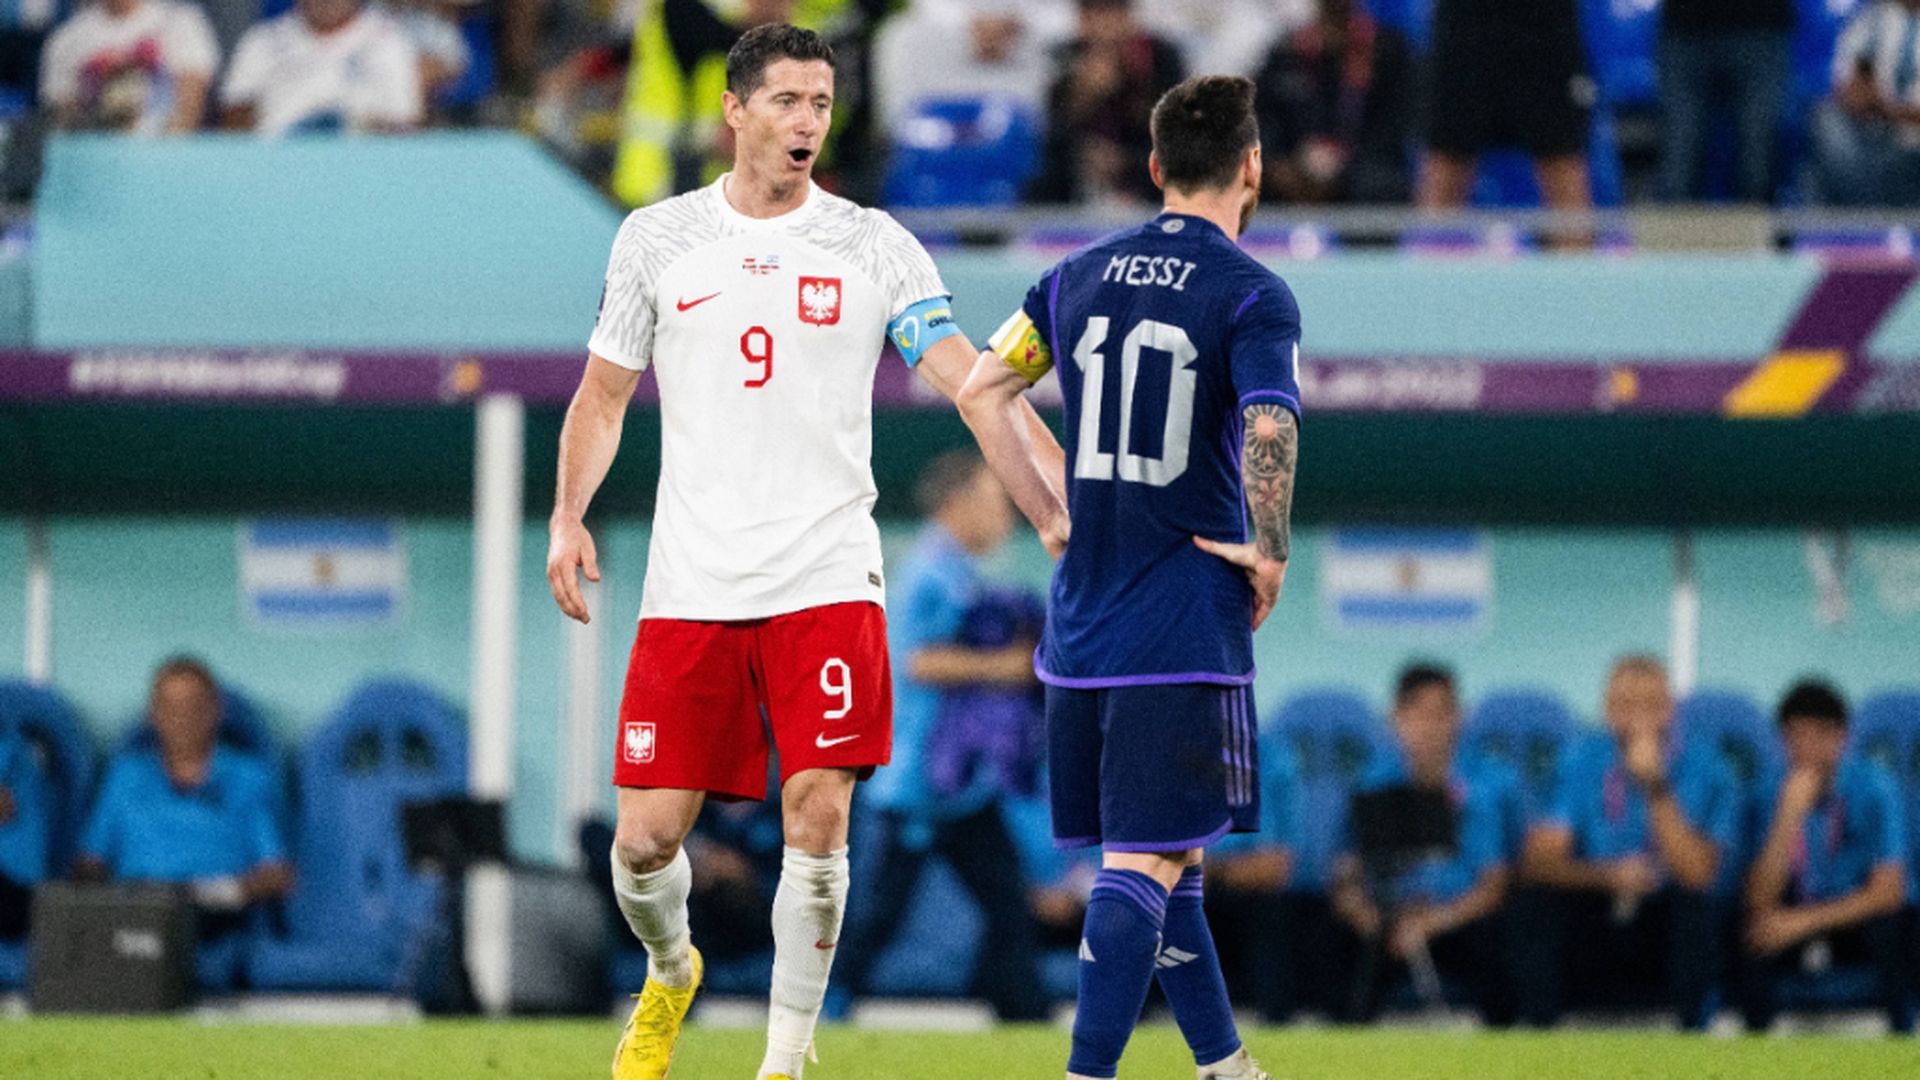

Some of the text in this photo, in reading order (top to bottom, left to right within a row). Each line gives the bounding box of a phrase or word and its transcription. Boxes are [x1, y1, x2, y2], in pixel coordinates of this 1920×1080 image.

[1103, 254, 1197, 291] MESSI
[740, 325, 774, 388] 9
[1071, 315, 1199, 487] 10
[819, 657, 853, 719] 9
